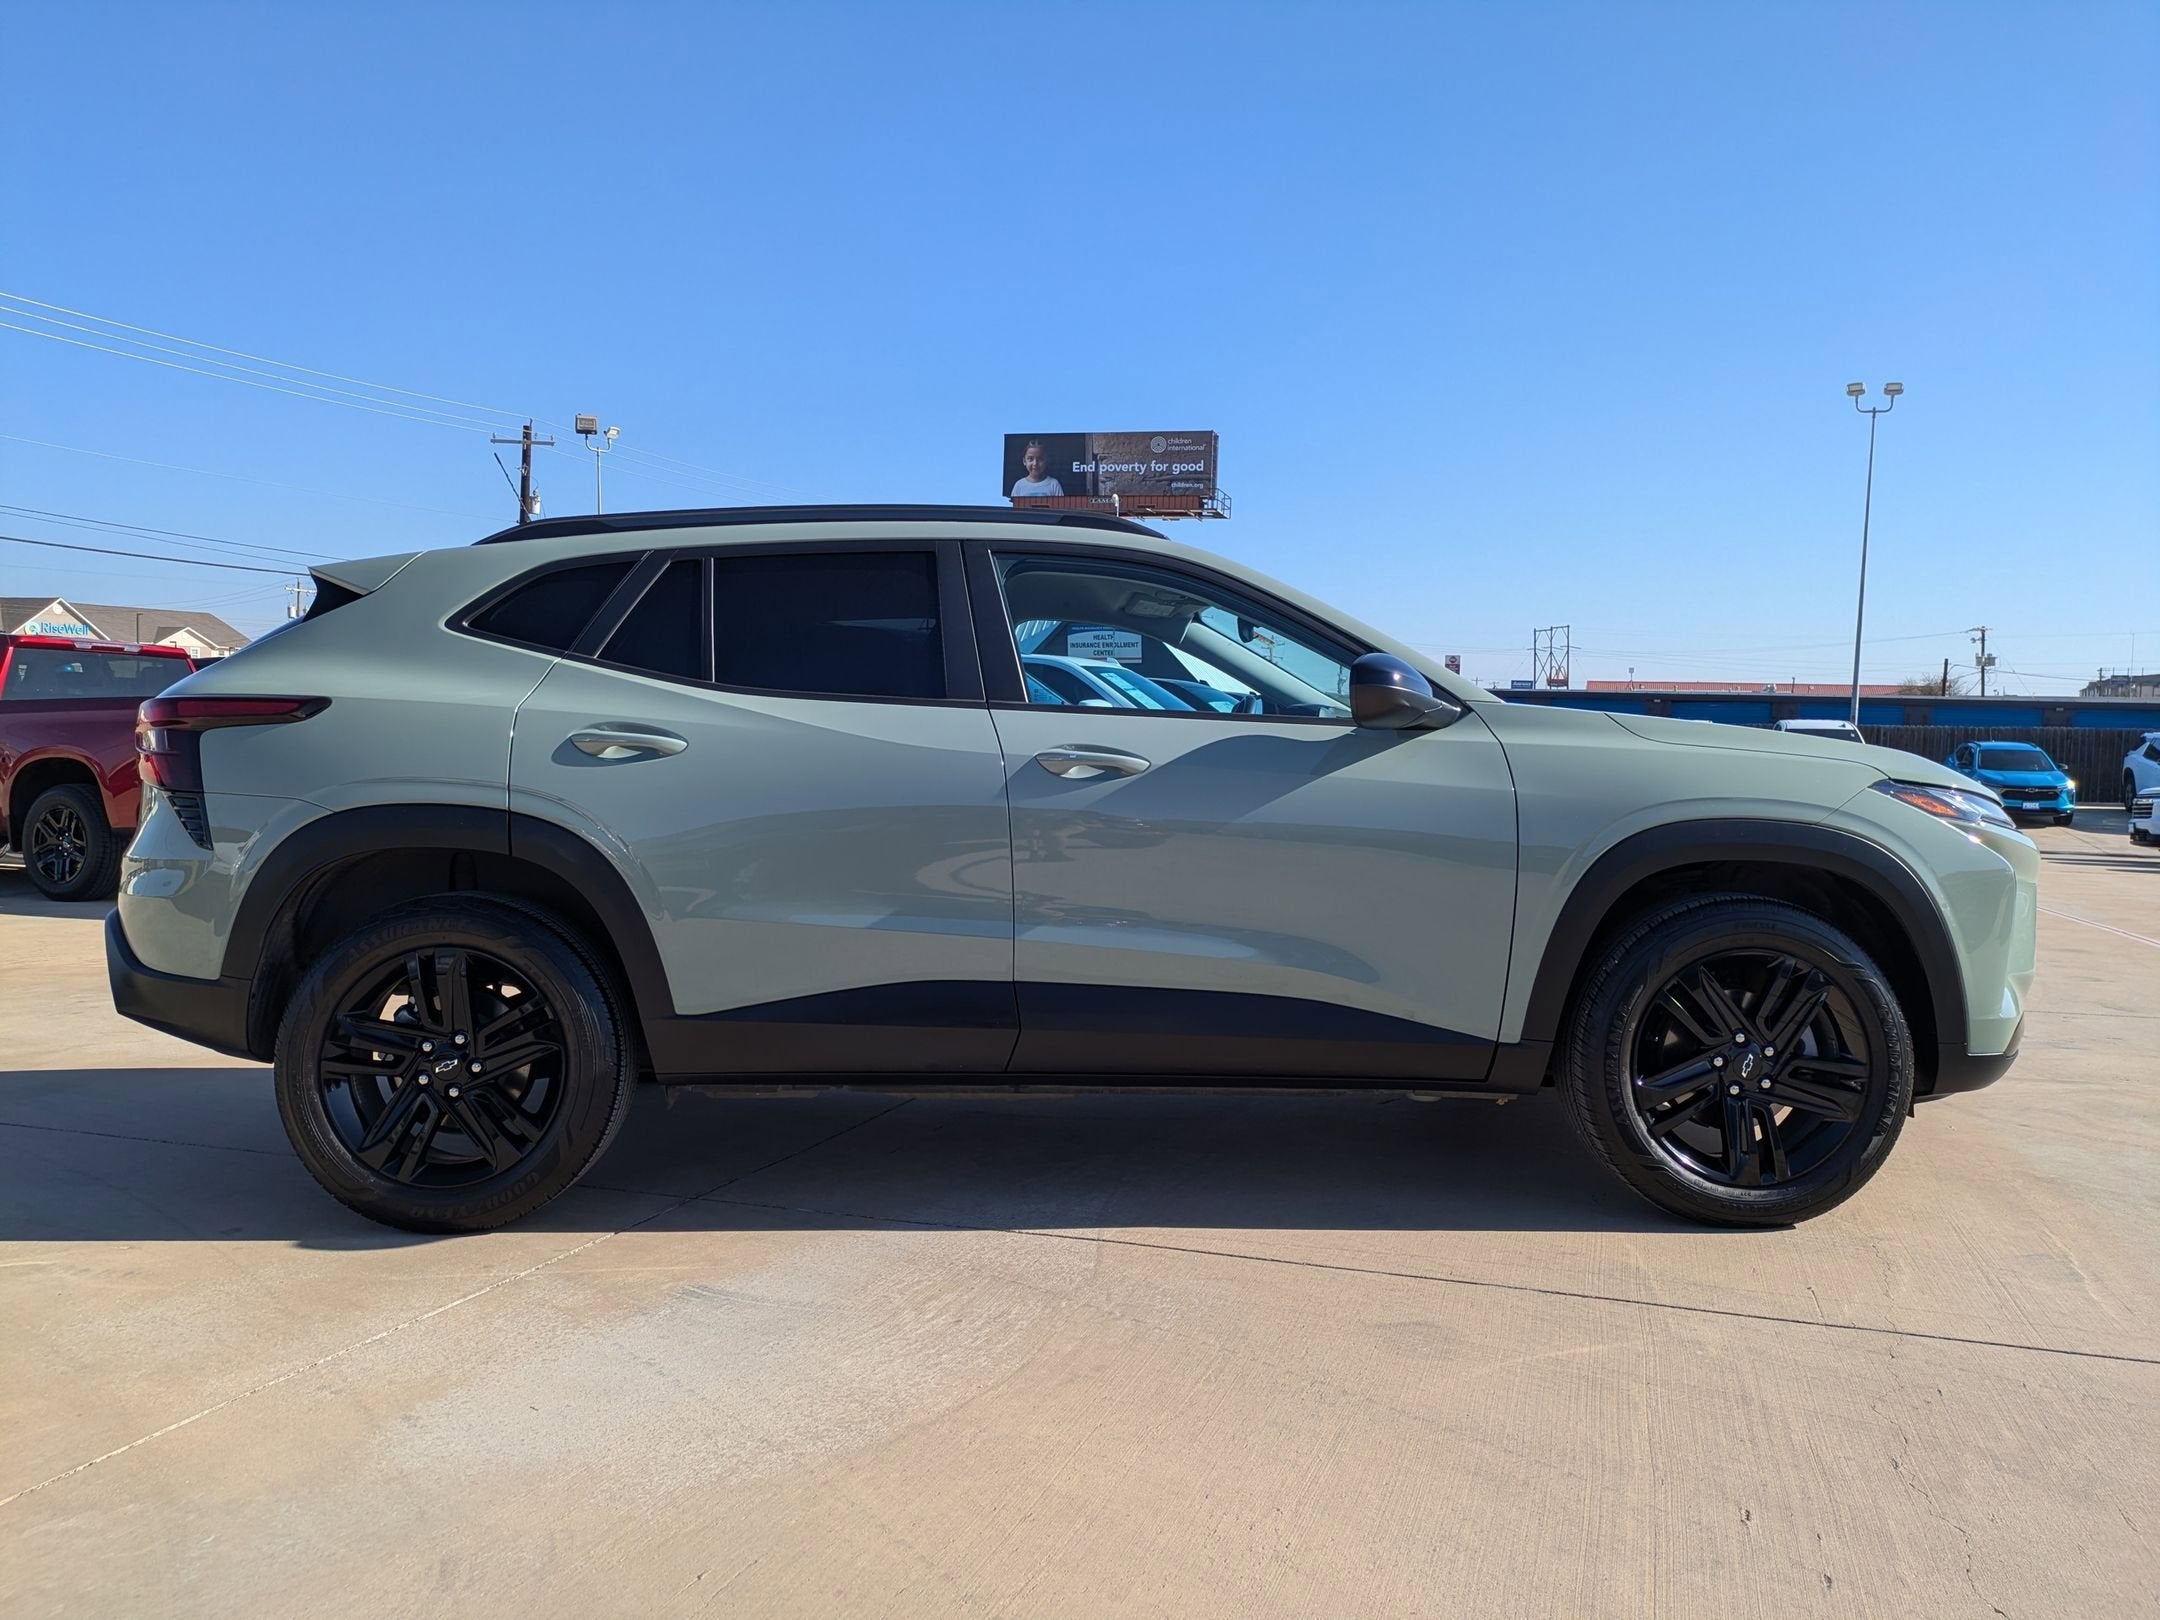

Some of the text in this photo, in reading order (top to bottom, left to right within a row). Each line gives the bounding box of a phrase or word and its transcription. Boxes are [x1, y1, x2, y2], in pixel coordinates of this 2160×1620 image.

[1072, 460, 1204, 474] End poverty for good
[1171, 481, 1204, 489] children.org
[41, 622, 88, 635] RiseWell
